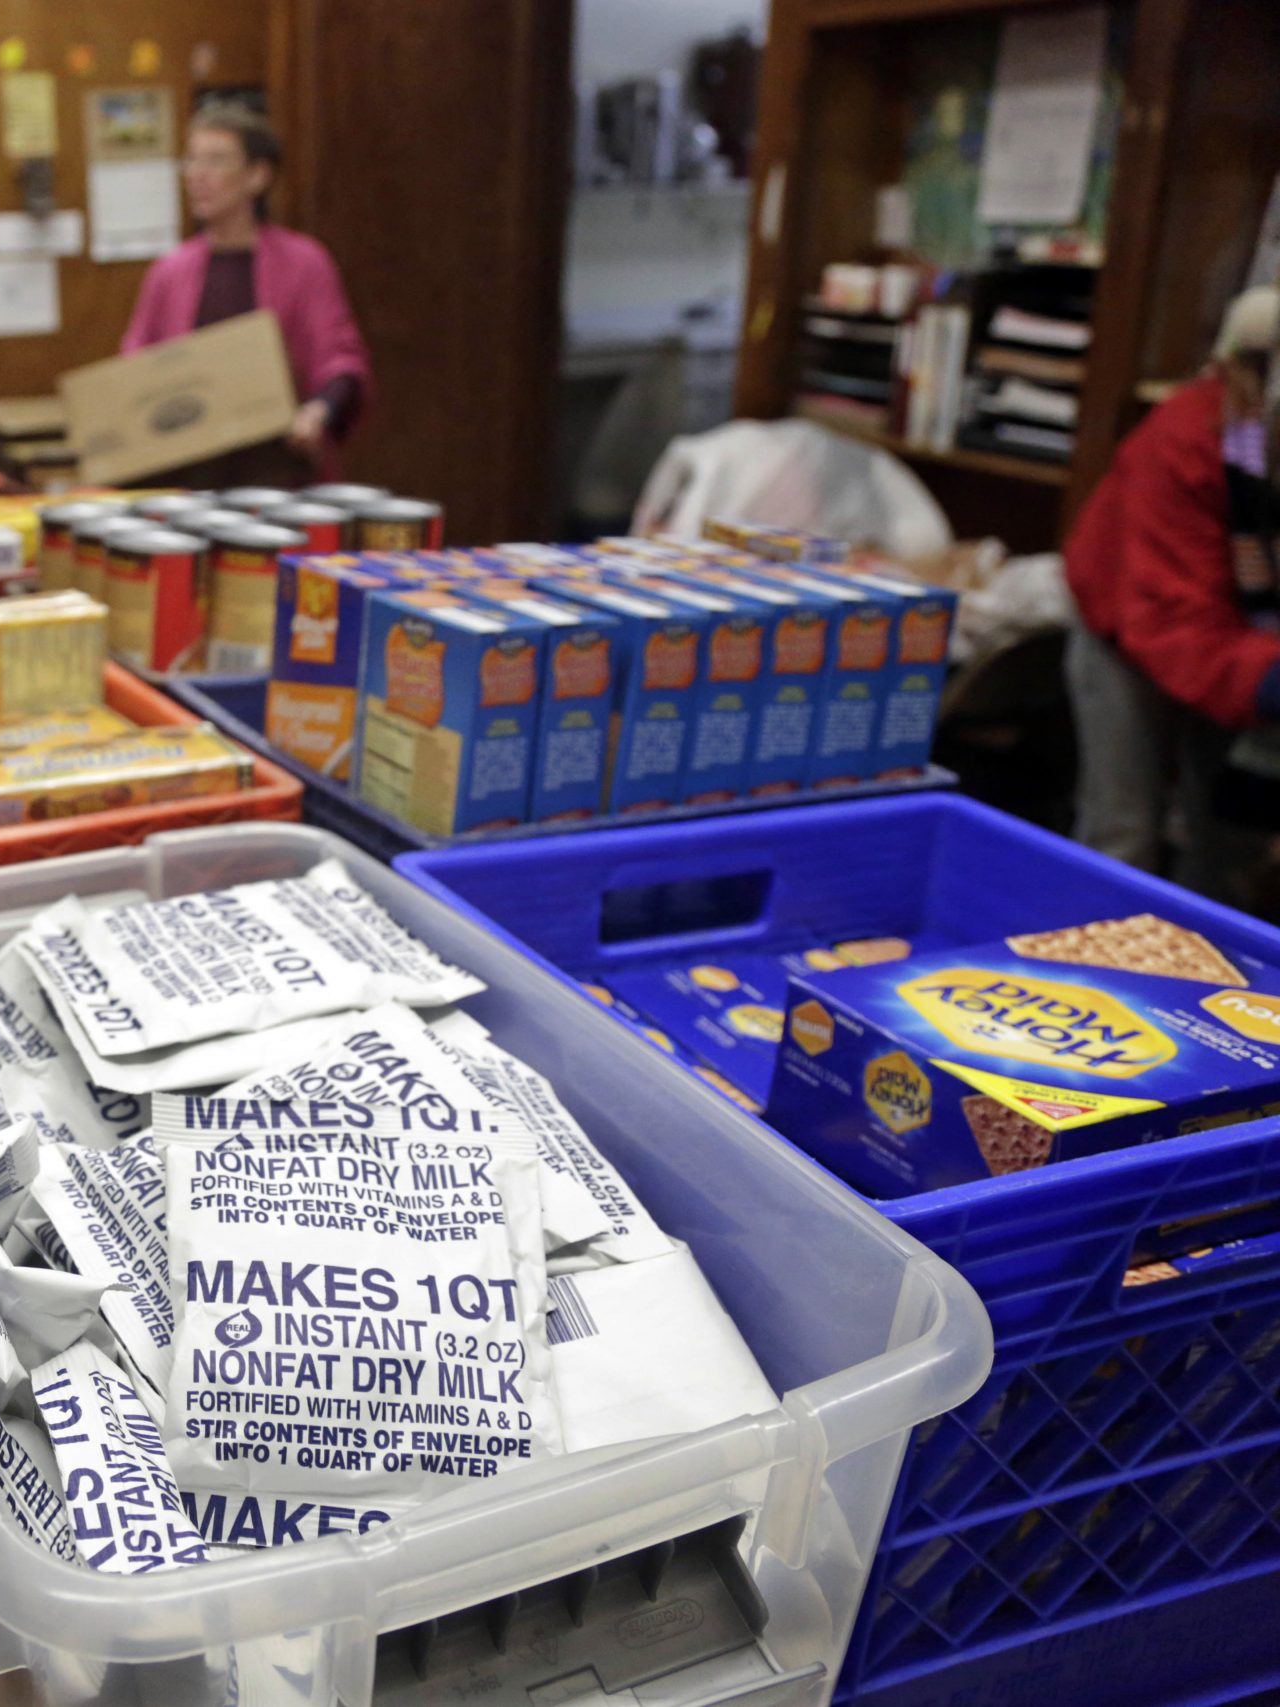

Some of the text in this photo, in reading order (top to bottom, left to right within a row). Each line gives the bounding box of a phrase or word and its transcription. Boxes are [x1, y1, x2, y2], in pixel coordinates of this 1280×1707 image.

[264, 946, 327, 992] 1QT.
[915, 983, 1154, 1067] Honey
[976, 981, 1143, 1044] Maid
[870, 1080, 930, 1120] Honey
[876, 1066, 921, 1097] Maid
[184, 1095, 375, 1130] MAKES
[265, 1132, 400, 1160] INSTANT
[407, 1142, 450, 1164] (3.2
[195, 1150, 495, 1191] NONFAT DRY MILK
[190, 1177, 504, 1210] FORTIFIED WITH VITAMINS A & D
[190, 1193, 506, 1228] STIR CONTENTS OF ENVELOPE
[66, 1153, 87, 1188] STIR
[86, 1184, 137, 1261] CONTENTS
[132, 1259, 152, 1280] OF
[120, 1199, 151, 1242] WITH
[218, 1209, 478, 1243] INTO 1 QUART OF WATER
[59, 1179, 88, 1209] INTO
[88, 1223, 126, 1269] QUART
[131, 1294, 171, 1349] WATER
[187, 1259, 399, 1312] MAKES
[274, 1312, 428, 1352] INSTANT
[435, 1331, 479, 1361] (3.2
[192, 1348, 524, 1404] NONFAT DRY MILK
[186, 1390, 532, 1431] FORTIFIED WITH VITAMINS A & D
[185, 1418, 531, 1458] STIR CONTENTS OF ENVELOPE
[215, 1441, 498, 1479] INTO 1 QUART OF WATER
